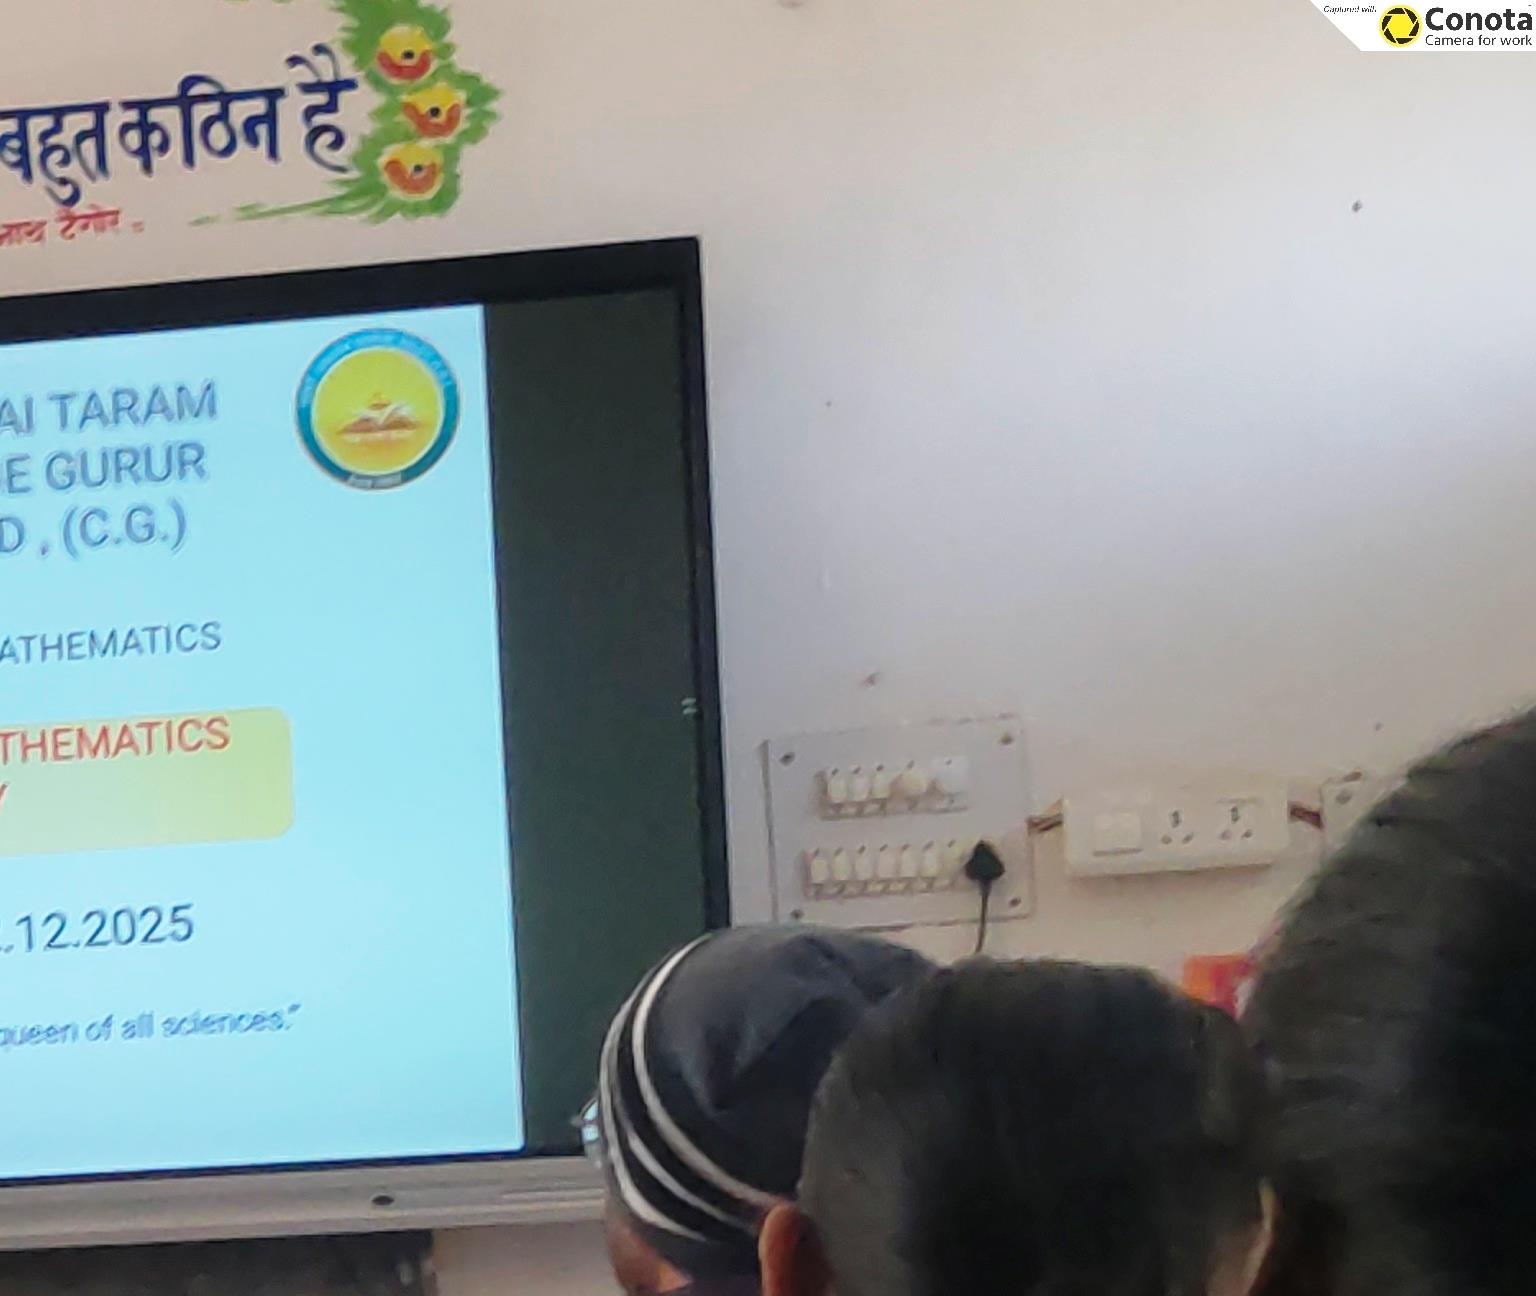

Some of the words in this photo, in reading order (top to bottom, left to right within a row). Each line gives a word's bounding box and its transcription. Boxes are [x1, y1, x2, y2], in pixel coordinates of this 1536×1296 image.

[120, 74, 286, 176] कठिन
[286, 42, 359, 173] है
[49, 380, 218, 431] TARAM
[45, 440, 207, 492] GURUR
[63, 498, 188, 561] (C.G.)
[85, 1013, 114, 1043] of
[121, 1010, 154, 1040] all
